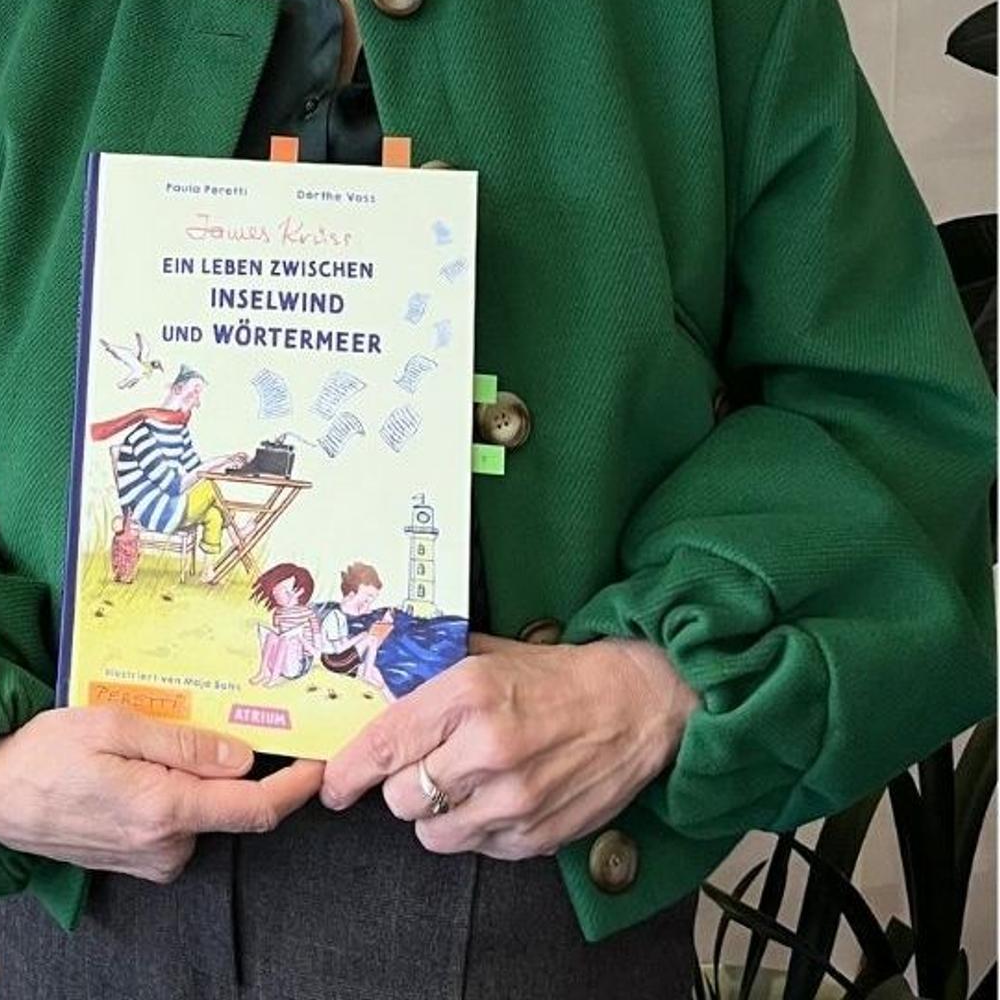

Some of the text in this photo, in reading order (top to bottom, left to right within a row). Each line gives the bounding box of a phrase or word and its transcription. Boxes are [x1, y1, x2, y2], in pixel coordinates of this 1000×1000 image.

[166, 183, 201, 194] Paula
[204, 184, 248, 196] Peretti
[346, 193, 376, 203] Voss
[185, 213, 270, 243] James
[163, 258, 374, 279] EIN LEBEN ZWISCHEN
[211, 288, 344, 314] INSELWIND
[163, 318, 382, 354] UND WÖRTERMEER
[161, 675, 181, 686] von
[236, 708, 287, 726] ATRIUM
